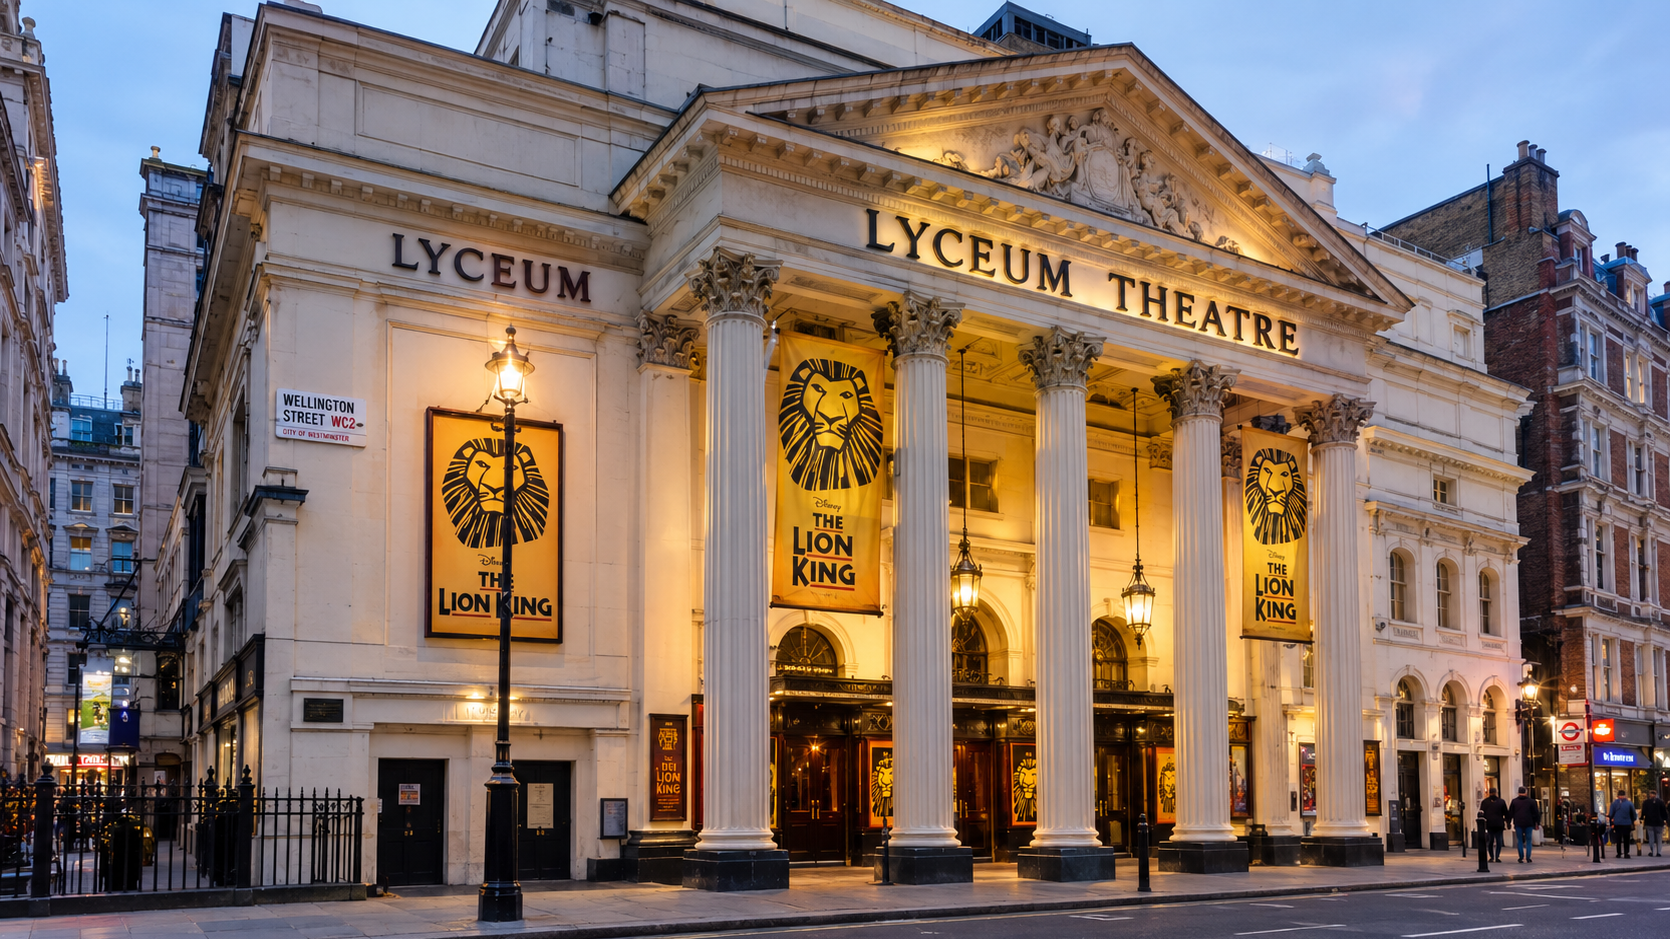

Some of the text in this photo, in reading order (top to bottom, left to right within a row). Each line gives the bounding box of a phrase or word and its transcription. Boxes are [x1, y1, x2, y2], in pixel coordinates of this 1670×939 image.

[391, 232, 592, 303] LYCEUM
[865, 207, 1300, 357] LYCEUM THEATRE
[283, 393, 355, 414] WELLINGTON
[283, 409, 356, 430] STREET WC2
[812, 512, 844, 530] THE
[793, 526, 853, 558] LION
[792, 555, 856, 587] KING
[1267, 562, 1288, 576] THE
[1255, 573, 1295, 597] LION
[438, 588, 491, 616] LION
[1255, 596, 1297, 622] KING
[656, 766, 681, 783] LION
